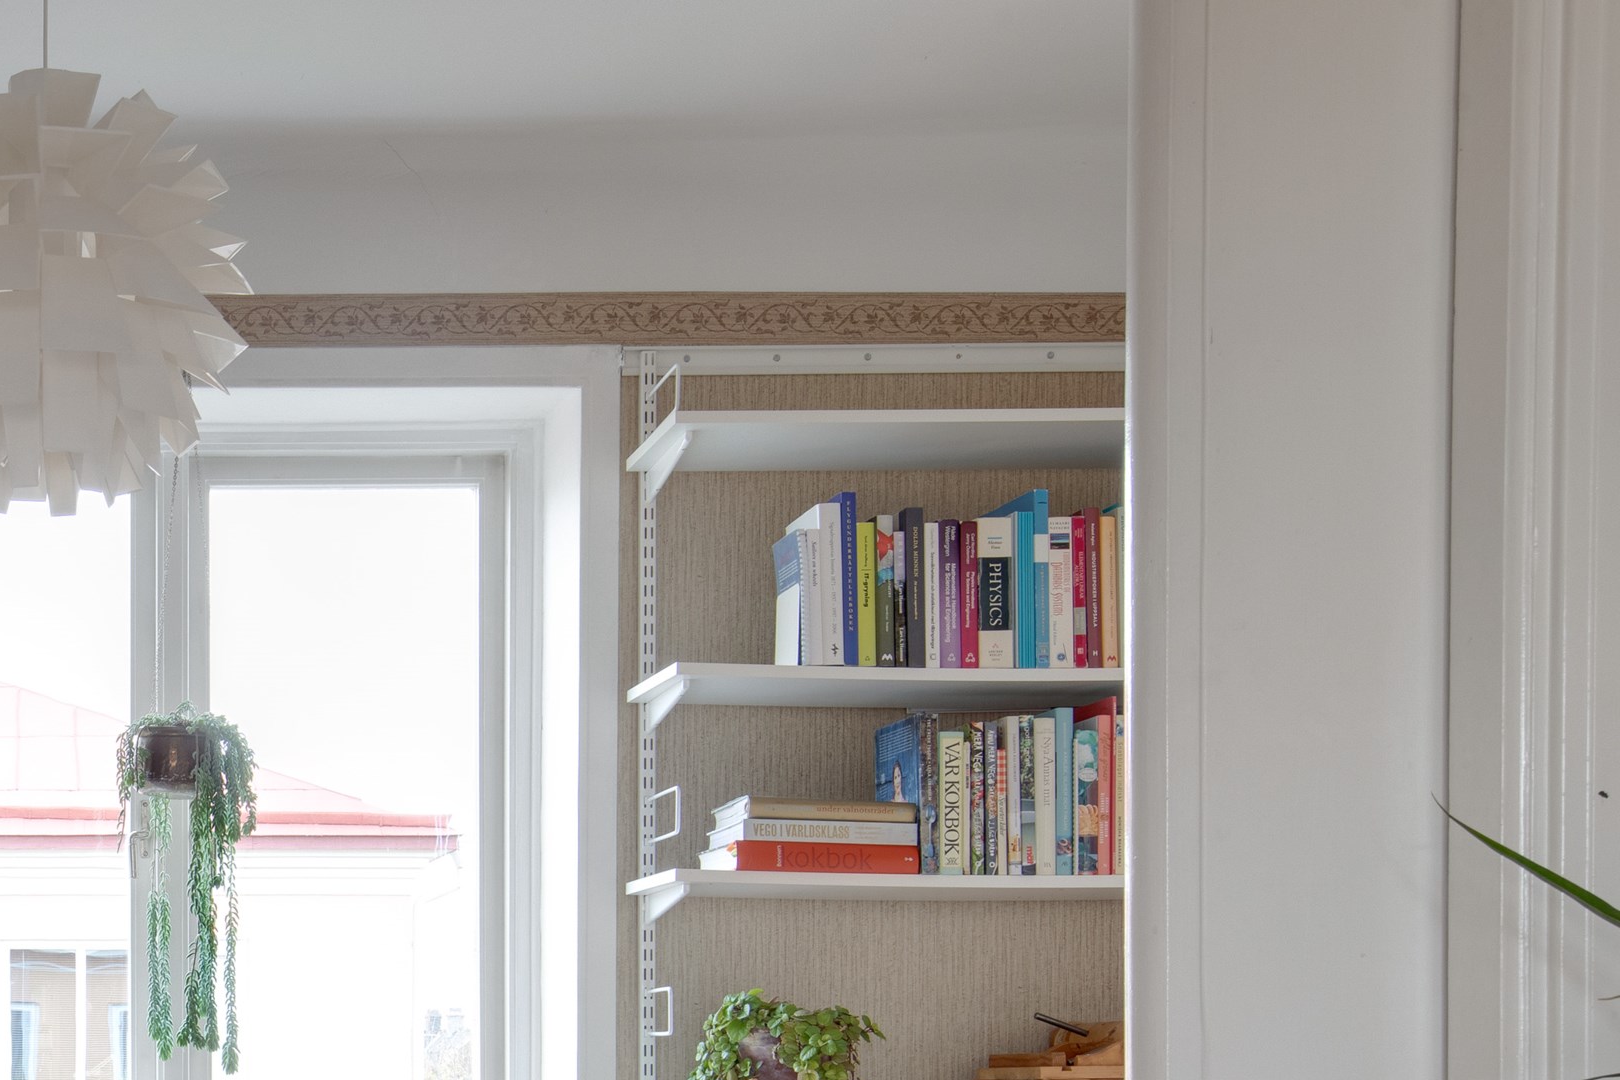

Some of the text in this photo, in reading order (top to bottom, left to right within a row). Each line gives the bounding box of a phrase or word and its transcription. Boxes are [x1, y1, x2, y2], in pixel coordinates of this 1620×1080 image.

[989, 563, 1002, 626] PHYSICS
[944, 608, 952, 642] Engineering
[1043, 737, 1052, 755] Nya
[1044, 756, 1054, 786] Annas
[944, 742, 962, 855] VÅR KOKBOK
[753, 823, 777, 837] VEGO
[786, 822, 850, 839] VÄRLDSKLASS
[782, 847, 873, 870] kokbok
